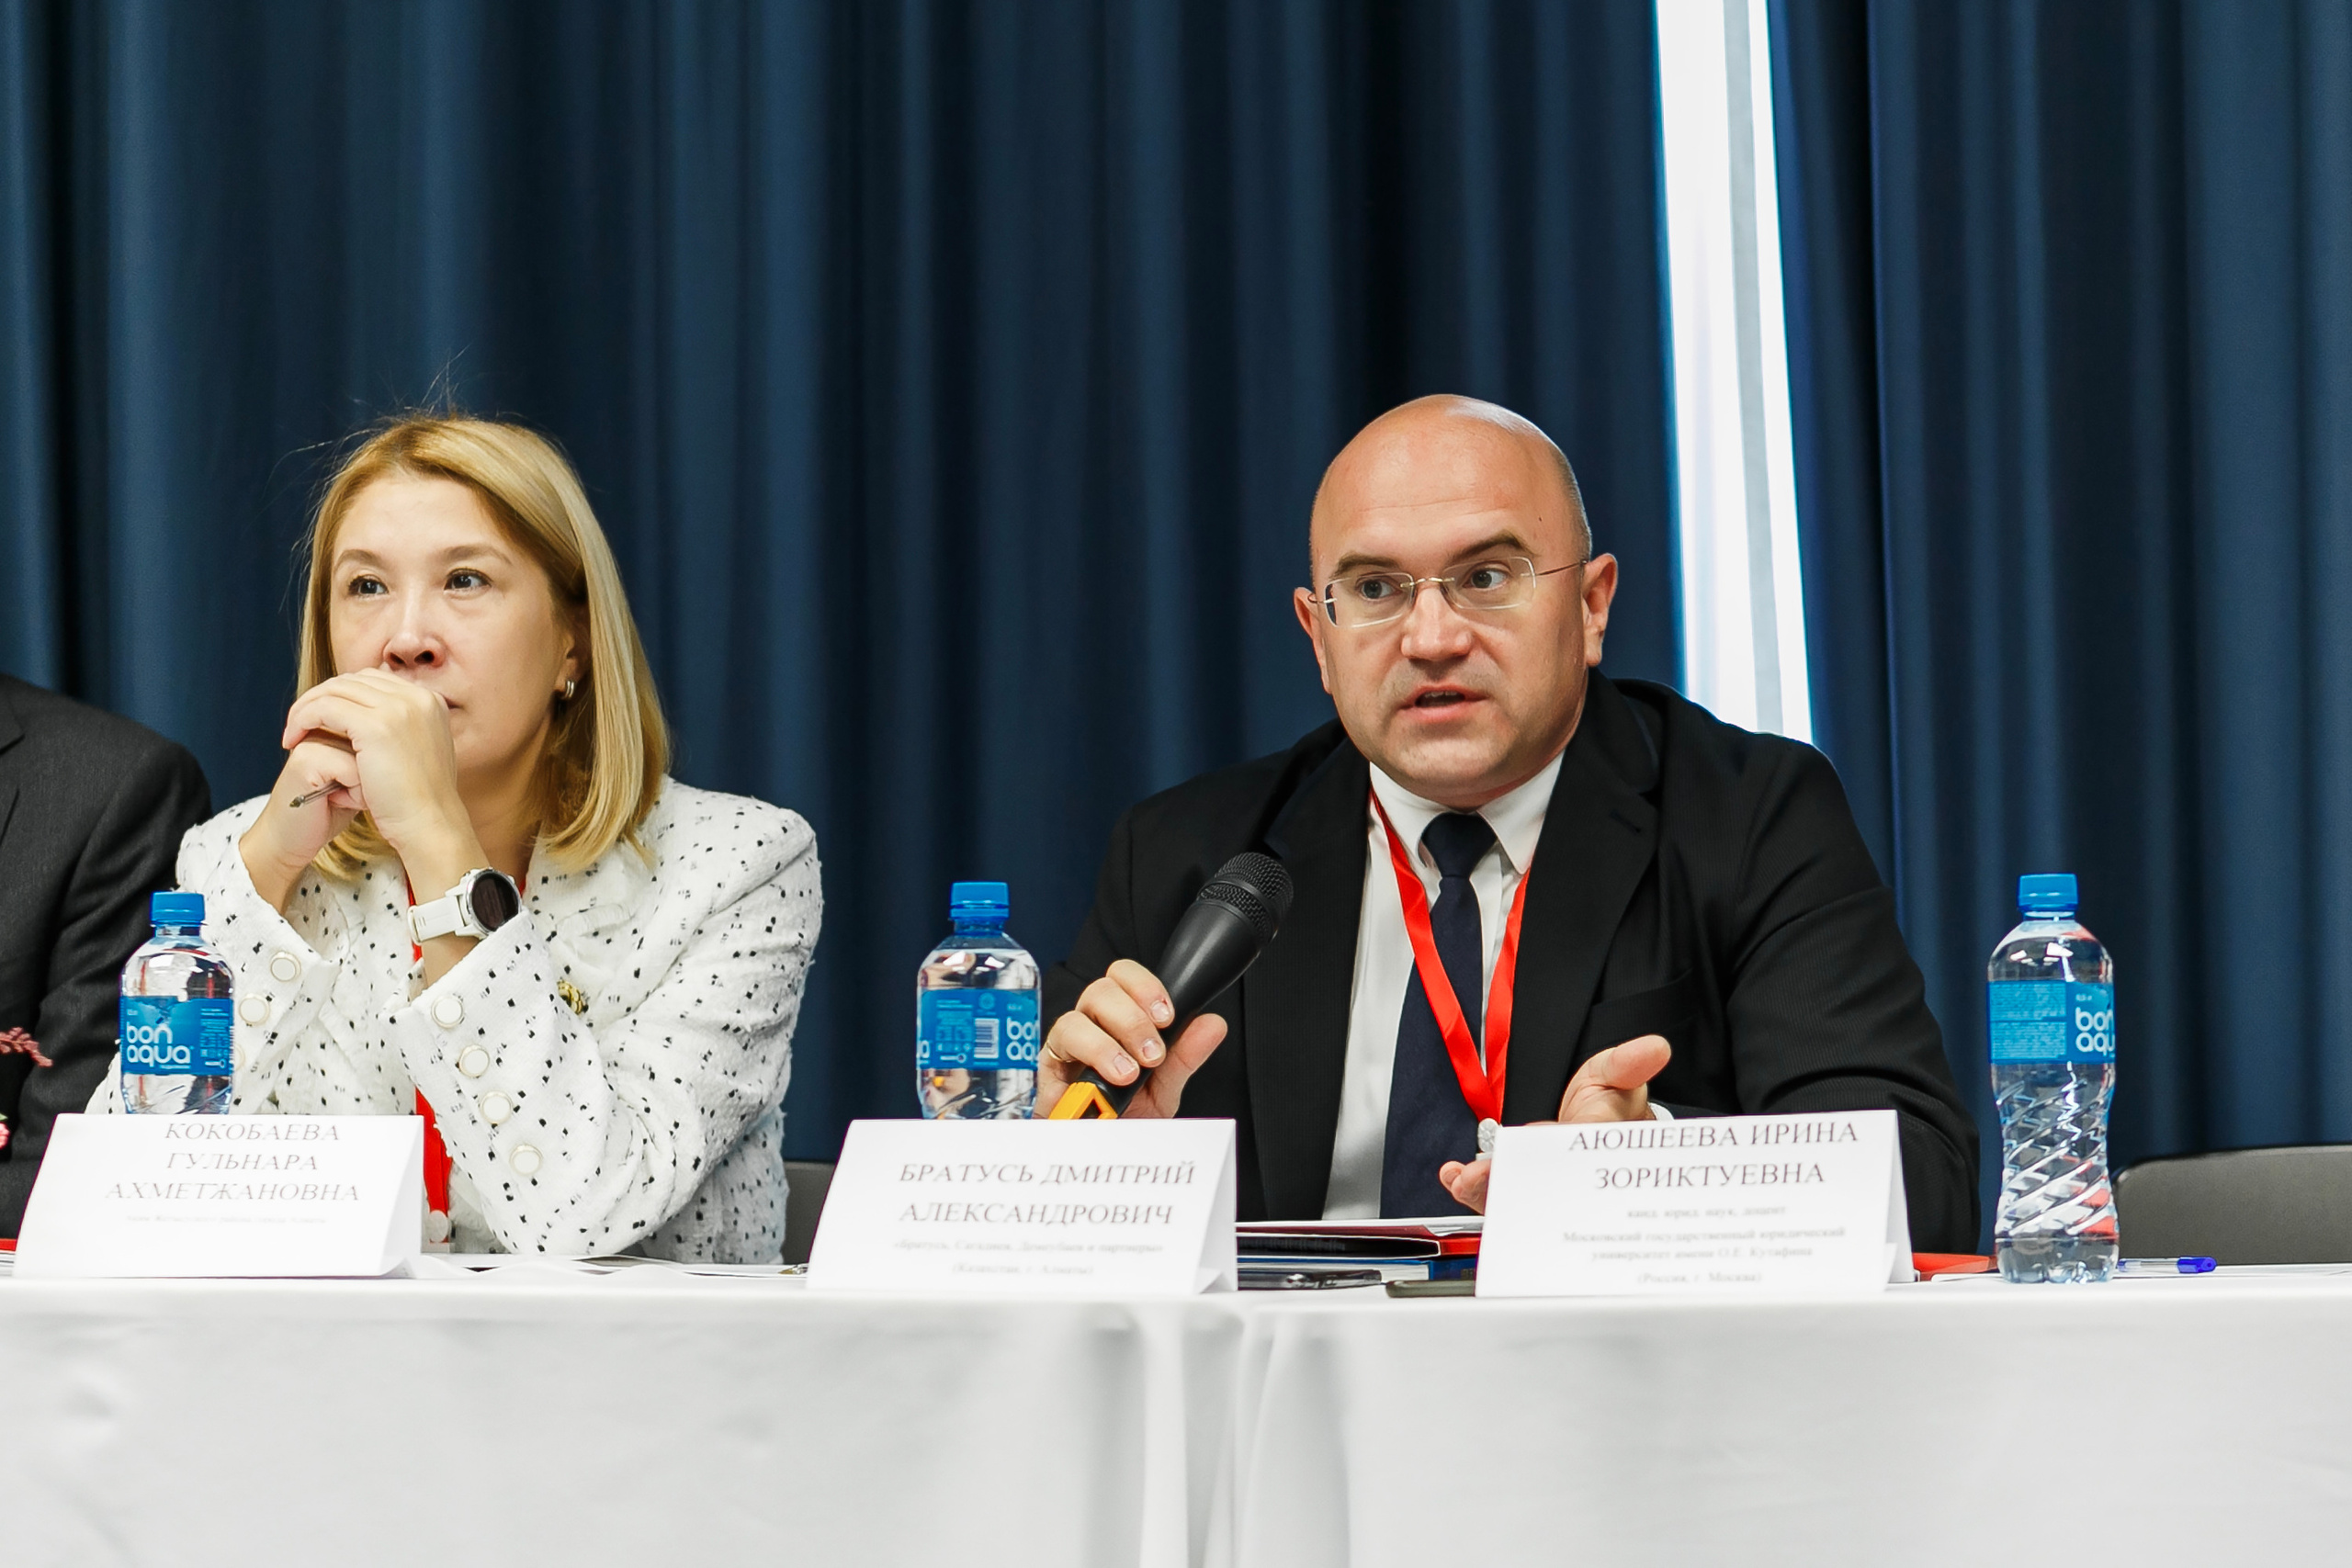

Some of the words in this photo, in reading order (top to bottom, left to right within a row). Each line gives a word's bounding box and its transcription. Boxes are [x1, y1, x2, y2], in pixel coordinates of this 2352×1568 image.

[127, 1021, 173, 1043] bon
[127, 1044, 191, 1067] aqua
[164, 1122, 340, 1141] КОКОБАЕВА
[1568, 1124, 1738, 1151] АЮШЕЕВА
[1750, 1122, 1859, 1145] ИРИНА
[166, 1153, 318, 1170] ГУЛЬНАРА
[899, 1163, 1034, 1183] БРАТУСЬ
[1040, 1160, 1195, 1185] ДМИТРИЙ
[1595, 1162, 1825, 1190] ЗОРИКТУЕВНА
[105, 1182, 359, 1201] АХМЕТЖАНОВНА
[899, 1202, 1173, 1226] АЛЕКСАНДРОВИЧ
